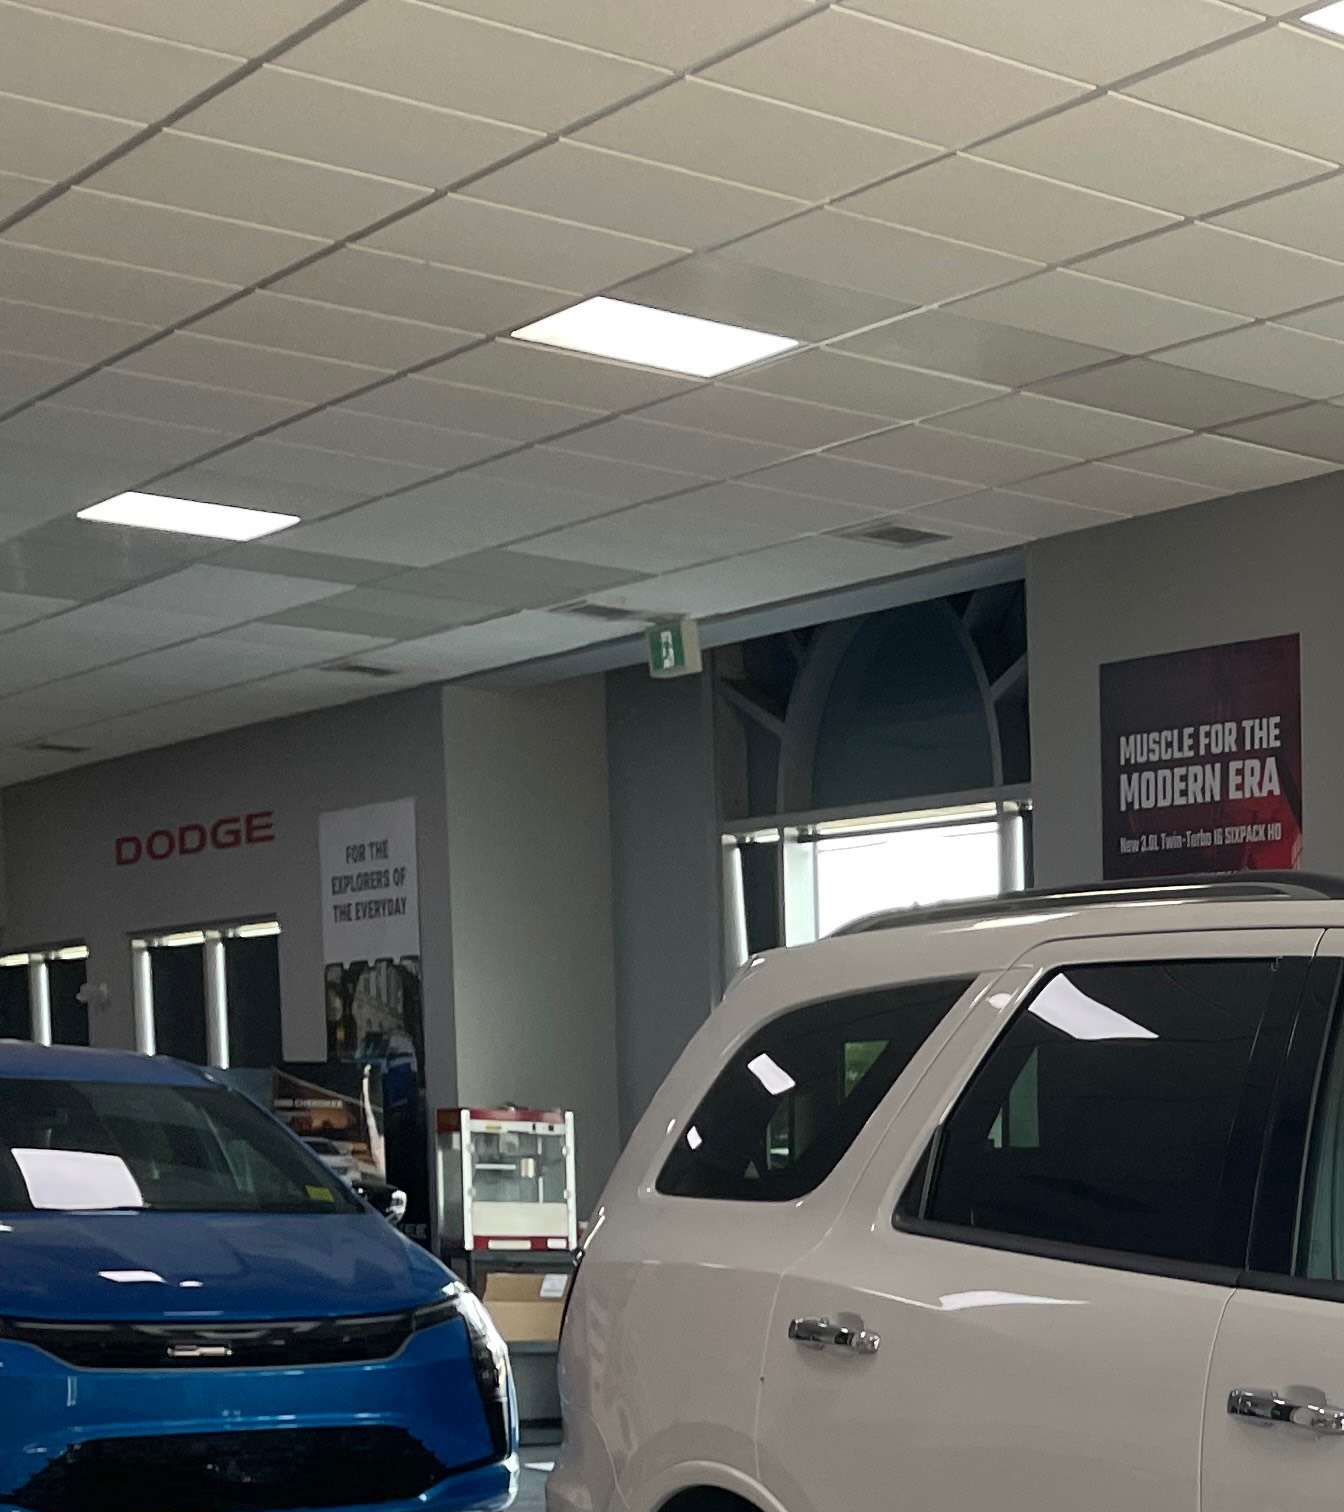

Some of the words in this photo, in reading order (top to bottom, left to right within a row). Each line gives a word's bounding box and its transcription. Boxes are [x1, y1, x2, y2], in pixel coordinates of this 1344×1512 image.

[1119, 727, 1195, 766] MUSCLE
[1200, 721, 1237, 756] FOR
[1242, 715, 1282, 750] THE
[1119, 762, 1222, 812] MODERN
[1228, 756, 1281, 800] ERA
[115, 811, 276, 866] DODGE
[345, 843, 366, 864] FOR
[368, 840, 389, 861] THE
[1120, 837, 1140, 854] New
[1225, 824, 1266, 844] SIXPACK
[331, 869, 390, 896] EXPLORERS
[392, 866, 406, 887] OF
[333, 903, 353, 923] THE
[355, 896, 407, 920] EVERYDAY
